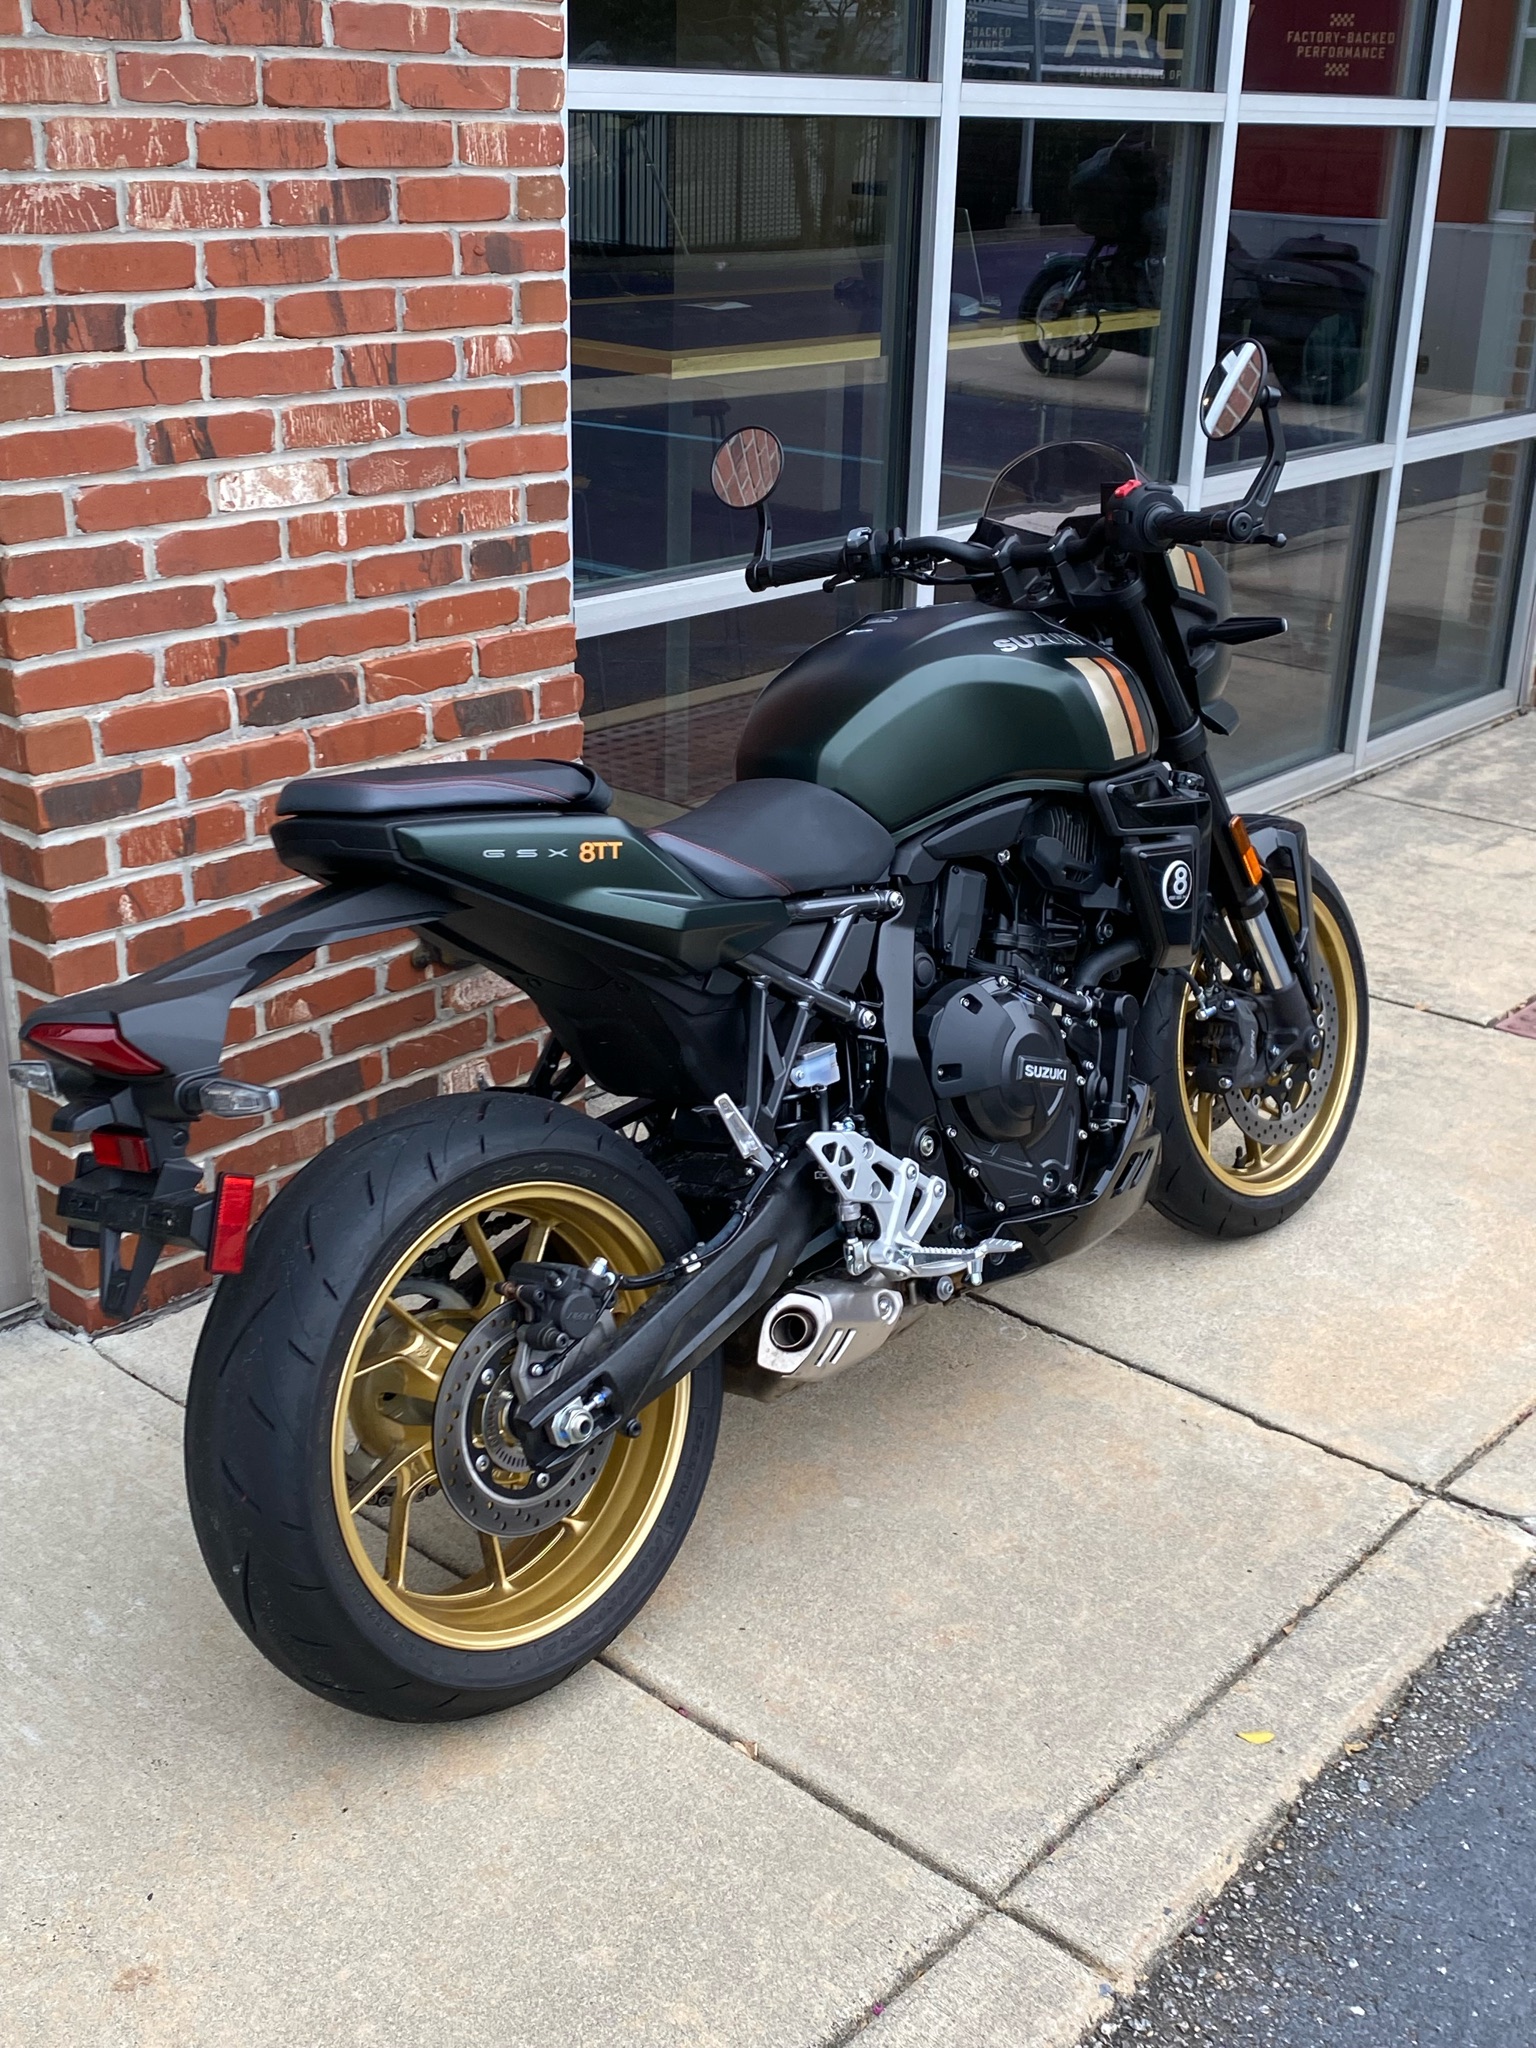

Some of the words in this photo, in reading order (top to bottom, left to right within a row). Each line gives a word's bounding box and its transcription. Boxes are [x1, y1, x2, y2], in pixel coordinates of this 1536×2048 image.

[1287, 31, 1396, 44] FACTORY-BACKED
[1297, 46, 1387, 59] PERFORMANCE
[993, 632, 1088, 653] SUZUKI
[579, 841, 624, 863] 8TT
[1173, 866, 1188, 896] 8
[1024, 1064, 1067, 1081] SUZUKI
